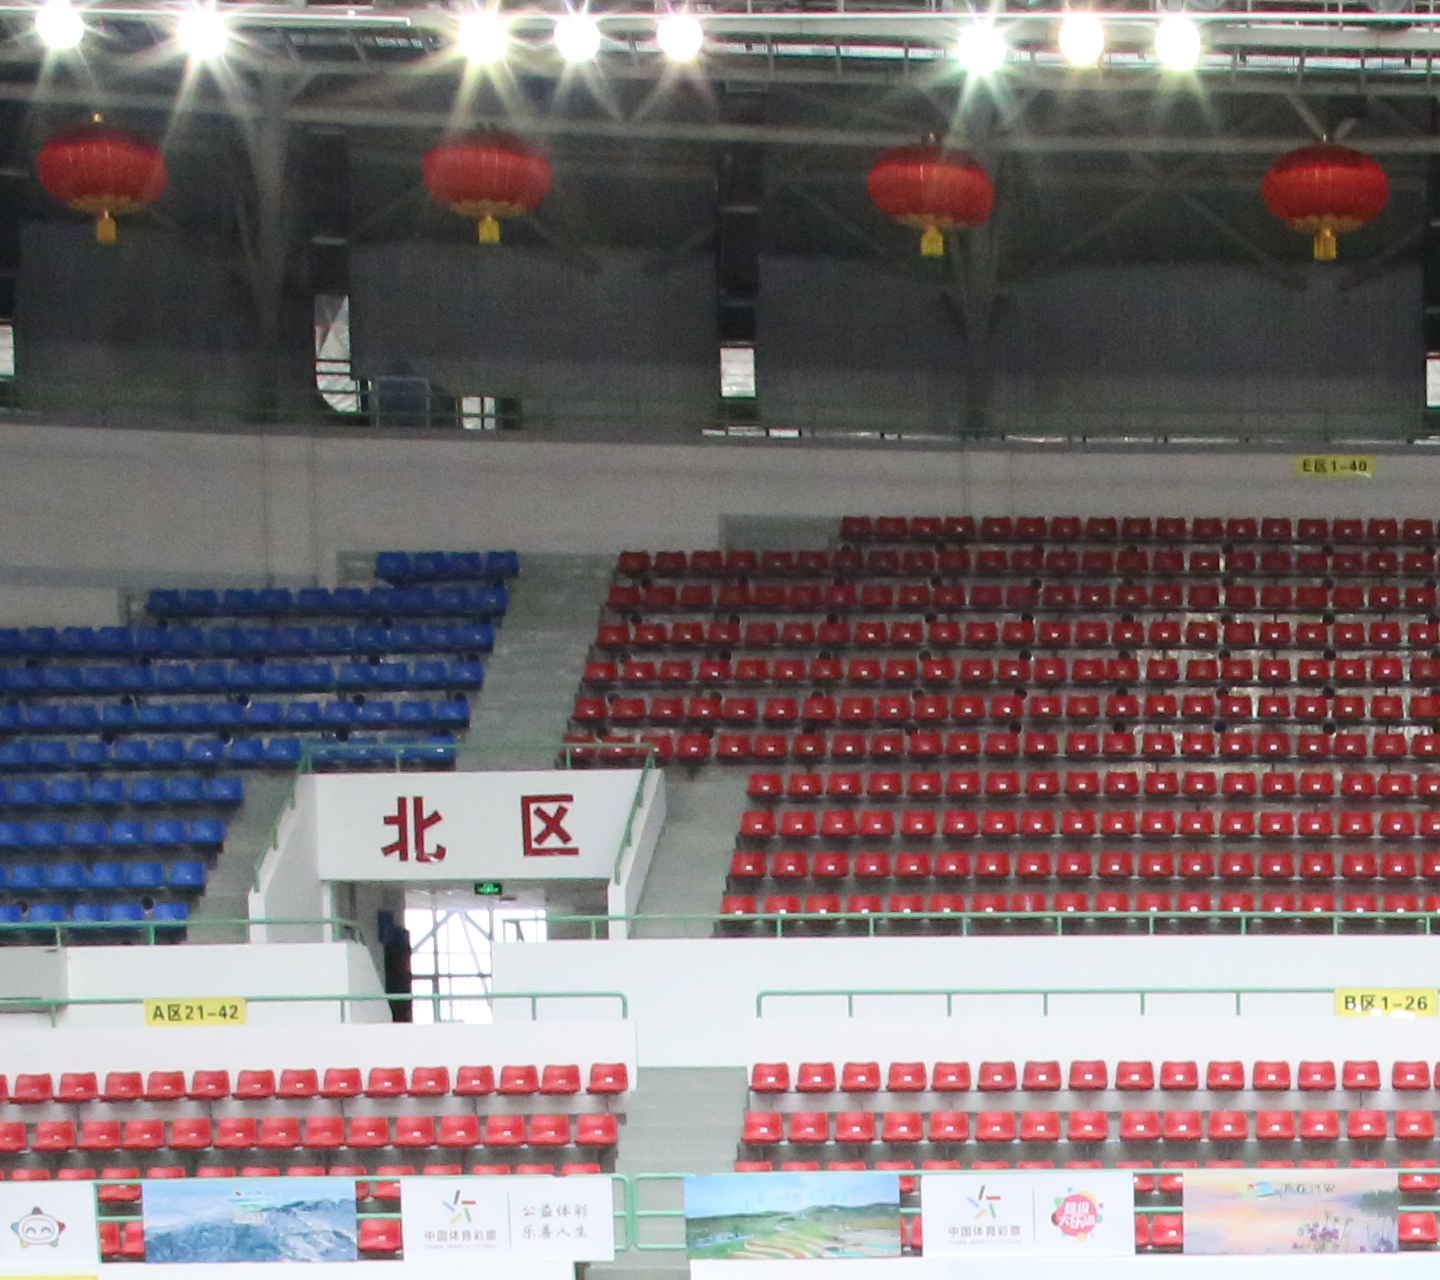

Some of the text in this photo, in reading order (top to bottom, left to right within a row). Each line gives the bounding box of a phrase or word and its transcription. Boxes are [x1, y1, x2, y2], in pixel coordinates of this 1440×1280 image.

[381, 794, 579, 863] 北区
[1343, 994, 1430, 1013] B区1-26
[151, 1003, 241, 1022] A区21-42
[522, 1204, 589, 1218] 公益体彩
[424, 1229, 498, 1242] 中国体育彩票
[522, 1224, 589, 1239] 乐善人生
[948, 1225, 1021, 1237] 中国体育彩票
